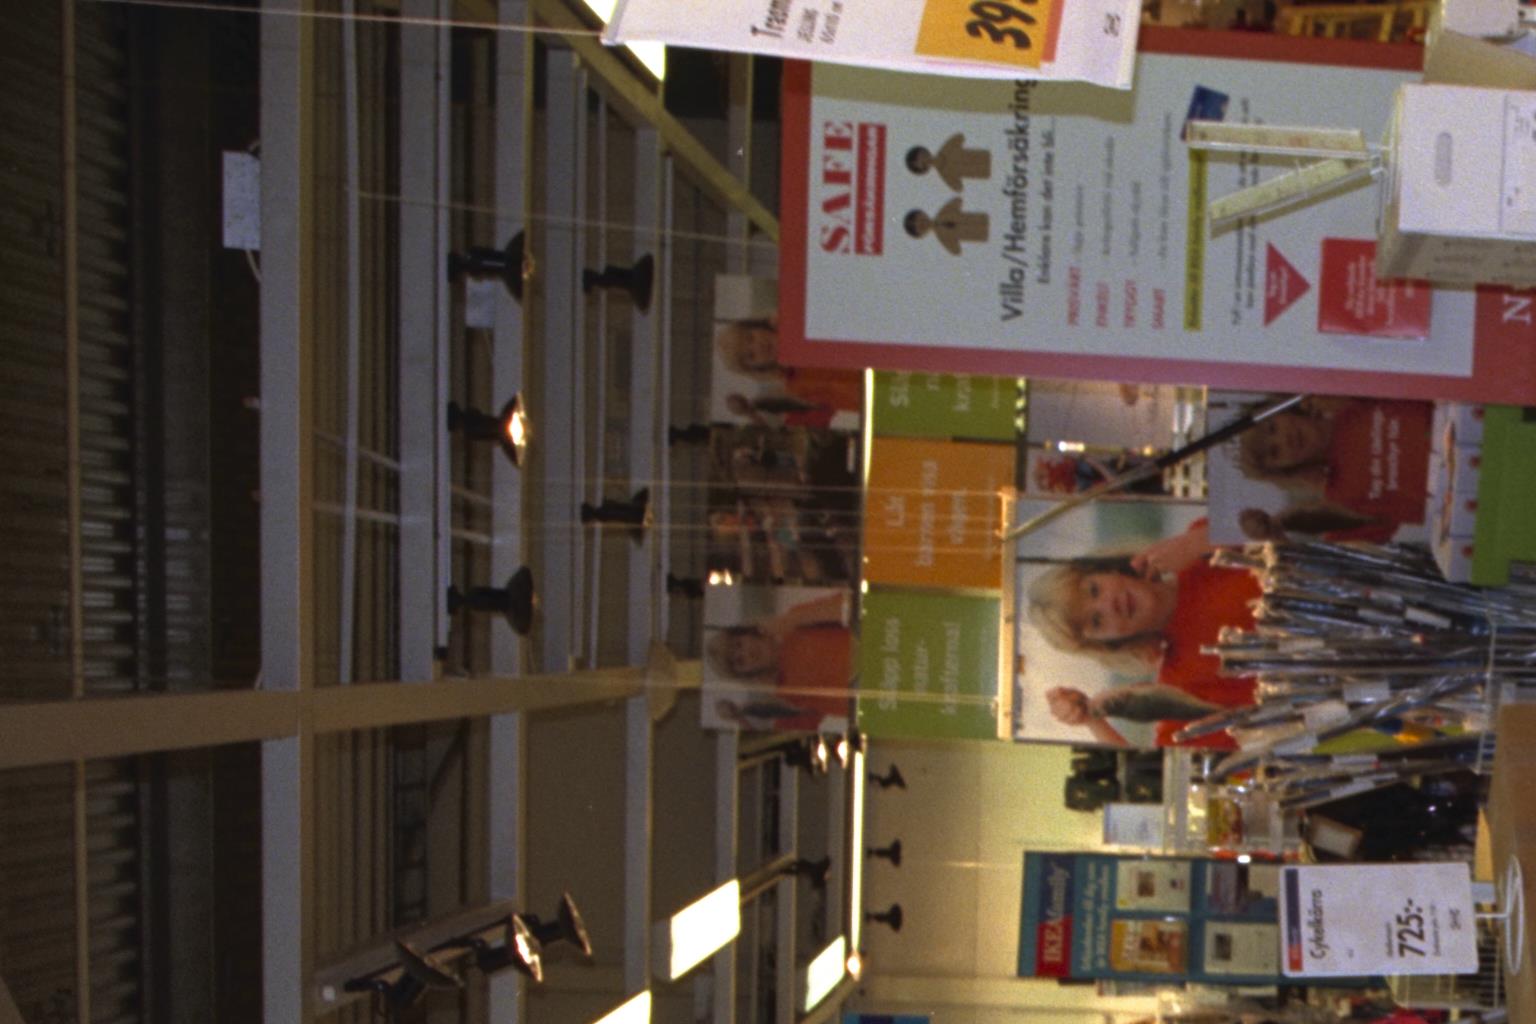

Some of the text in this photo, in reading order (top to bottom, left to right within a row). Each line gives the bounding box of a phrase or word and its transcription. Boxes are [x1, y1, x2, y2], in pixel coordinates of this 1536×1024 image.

[965, 0, 1038, 50] 39
[818, 120, 854, 254] SAFE
[1038, 178, 1054, 201] det
[1040, 150, 1054, 175] inte
[1000, 79, 1036, 322] Villa/Hemförsäkring
[1036, 205, 1053, 231] kan
[1036, 234, 1052, 284] Enklare
[878, 657, 902, 712] Säpp
[940, 621, 961, 715] kafterna!
[1309, 889, 1330, 960] Cykelkärra
[1395, 897, 1427, 958] 725:-
